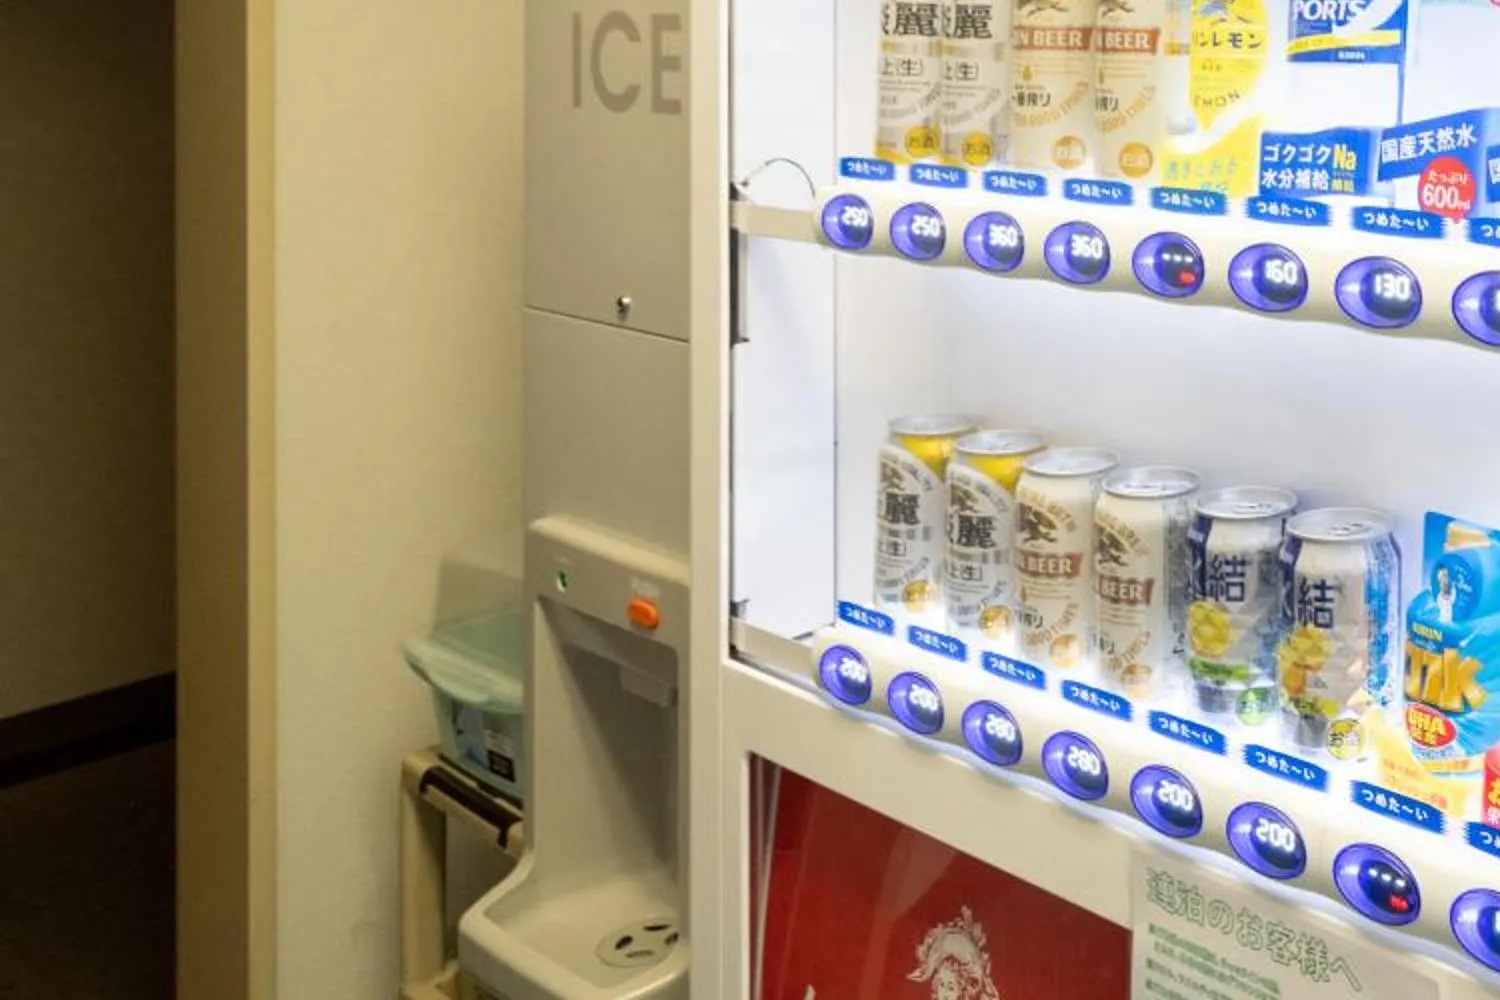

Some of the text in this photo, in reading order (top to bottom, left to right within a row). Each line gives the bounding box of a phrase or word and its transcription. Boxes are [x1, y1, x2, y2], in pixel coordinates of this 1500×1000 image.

[1032, 30, 1083, 47] BEER
[1105, 32, 1150, 49] BEER
[572, 10, 682, 115] ICE
[1263, 143, 1331, 165] ゴクゴク
[1332, 143, 1357, 170] Na
[1380, 123, 1477, 163] 国産天然水
[911, 215, 942, 239] 250
[1265, 260, 1298, 286] 160
[1374, 274, 1411, 301] 130
[1027, 554, 1074, 576] BEER
[1208, 554, 1248, 603] 結
[1101, 579, 1145, 601] BEER
[1299, 577, 1336, 629] 結
[1157, 780, 1194, 811] 200
[1255, 817, 1296, 852] 200
